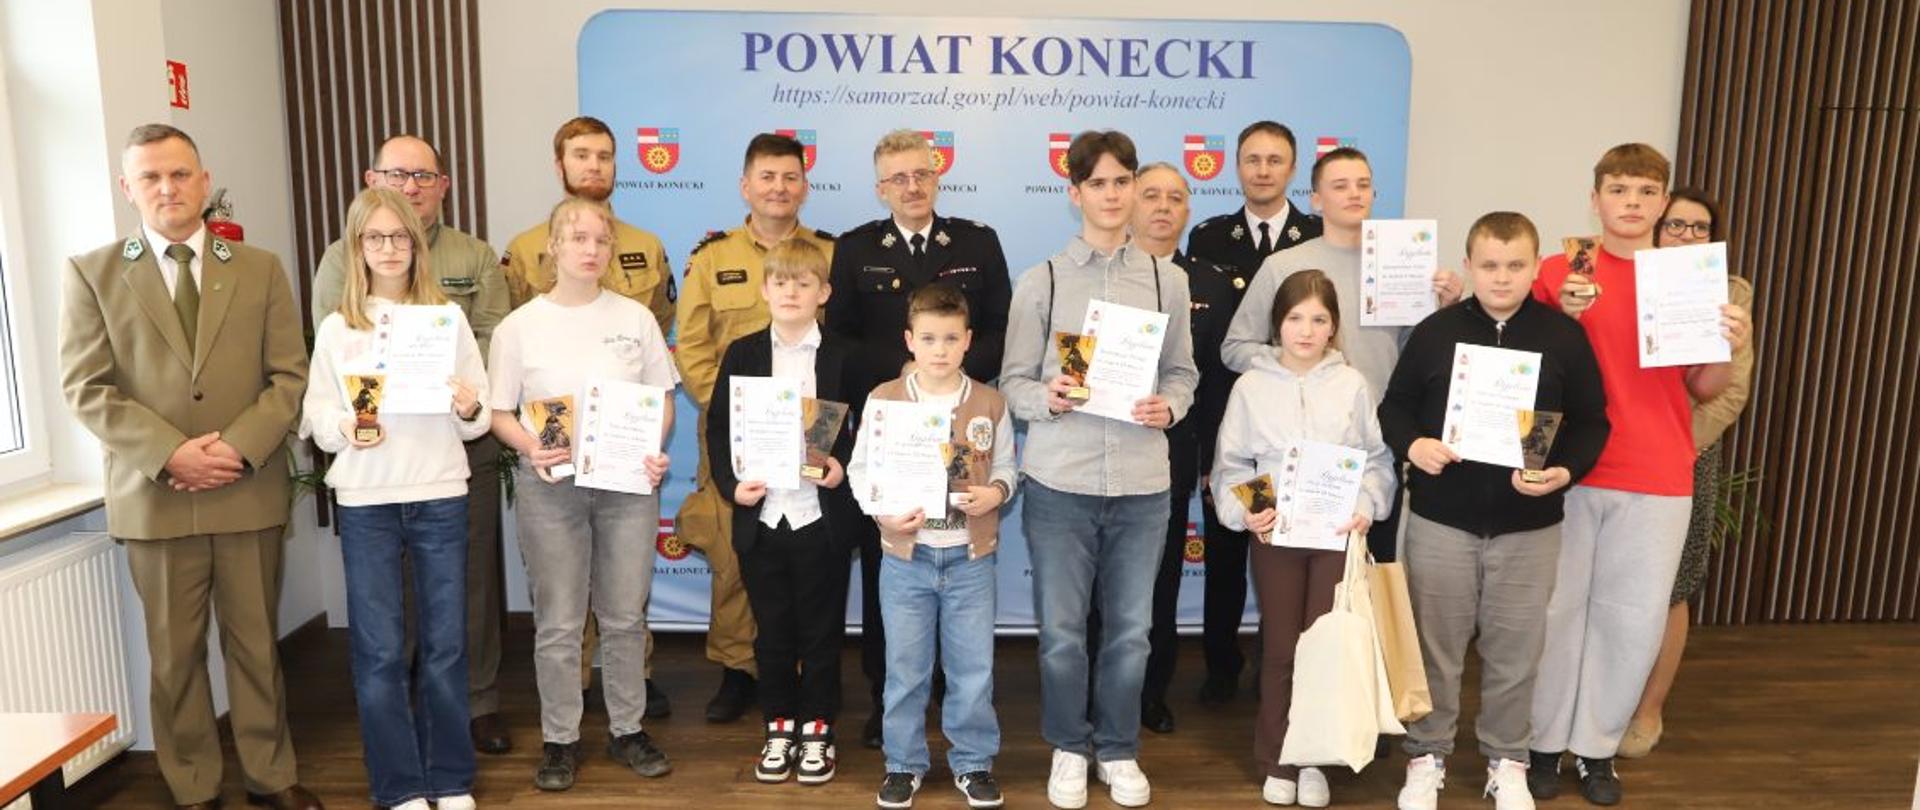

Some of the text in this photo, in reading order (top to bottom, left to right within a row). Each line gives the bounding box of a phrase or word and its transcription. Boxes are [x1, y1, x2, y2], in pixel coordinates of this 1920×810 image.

[741, 31, 1259, 79] POWIAT KONECKI
[772, 84, 1226, 112] https://samorzad.gov.pl/web/powiat-konecki
[615, 181, 704, 191] POWIAT KONECKI
[810, 183, 841, 191] NECKI
[1025, 185, 1064, 193] POWIAT
[1200, 187, 1243, 195] KONECK
